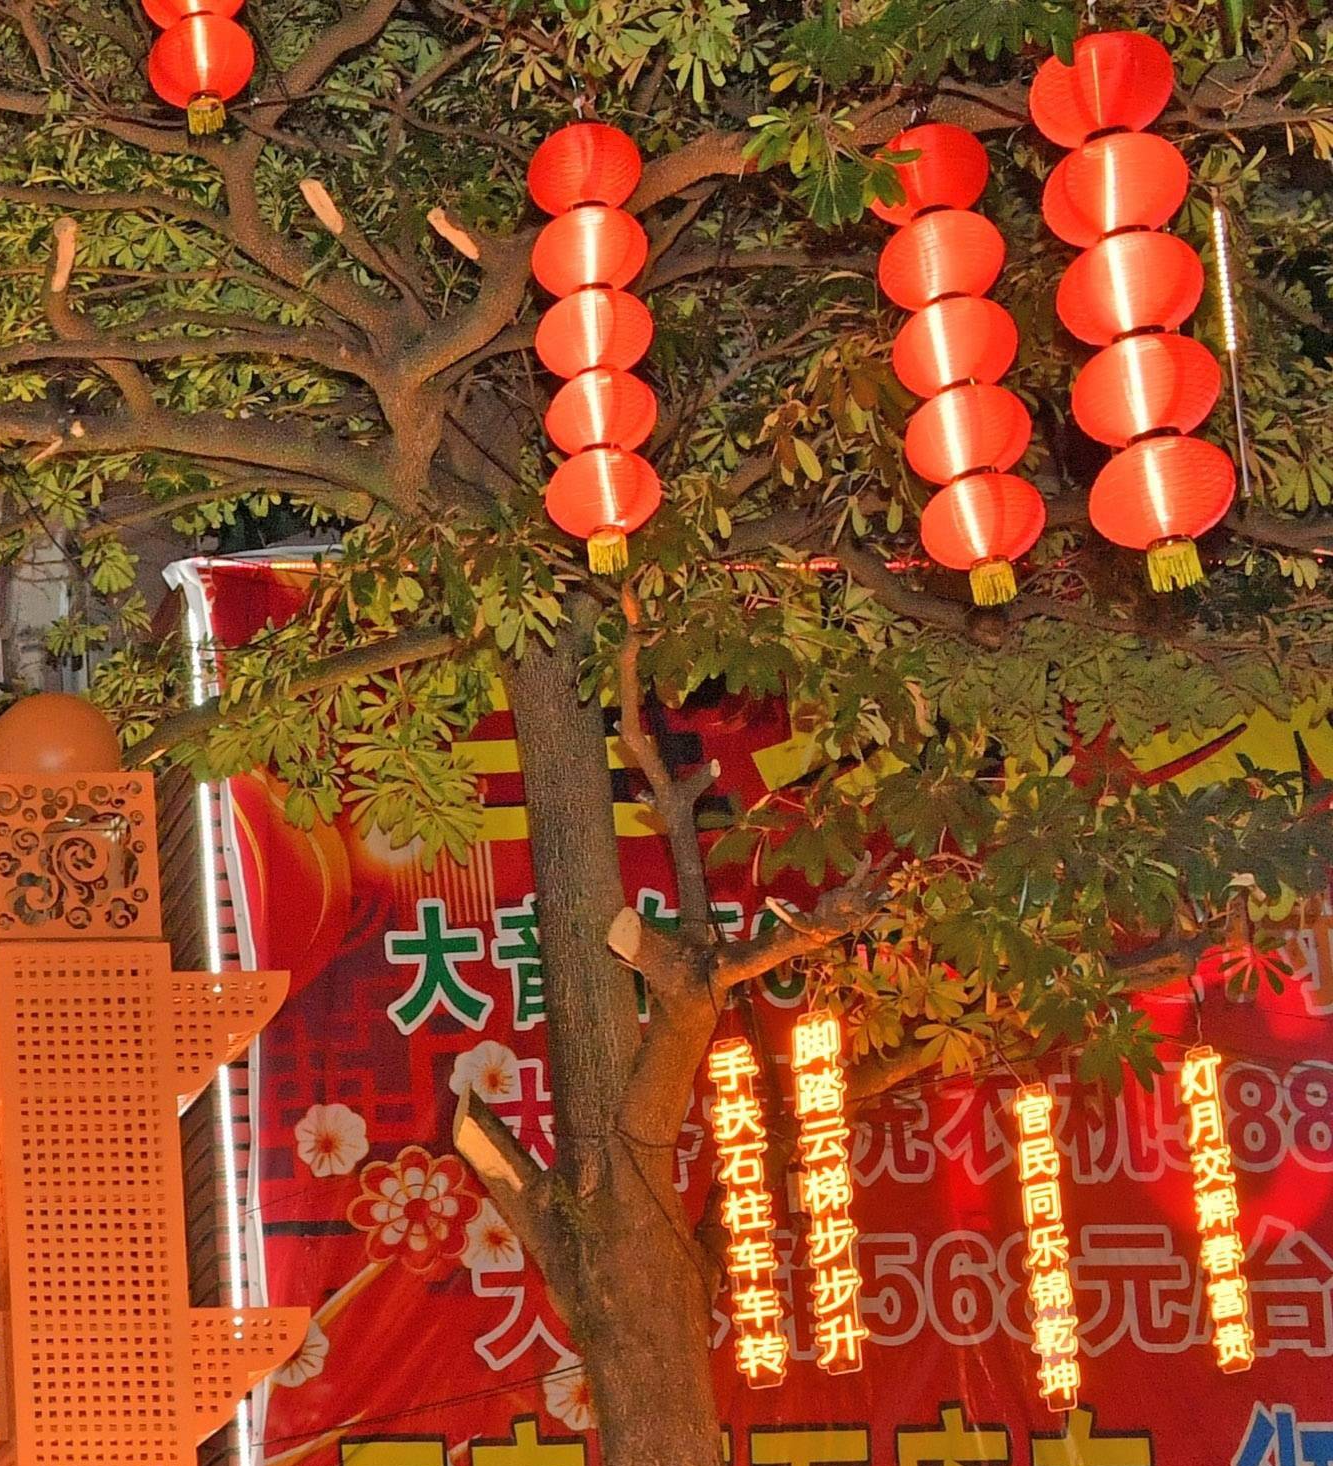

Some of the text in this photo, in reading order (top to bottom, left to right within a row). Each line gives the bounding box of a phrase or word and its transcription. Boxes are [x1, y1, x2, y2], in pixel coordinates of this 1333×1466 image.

[708, 1046, 787, 1378] 手扶石柱车车转
[792, 1018, 868, 1368] 脚踏云梯步步升
[1015, 1091, 1080, 1401] 官民同乐锦乾坤
[1180, 1055, 1252, 1369] 灯月交辉春富贵
